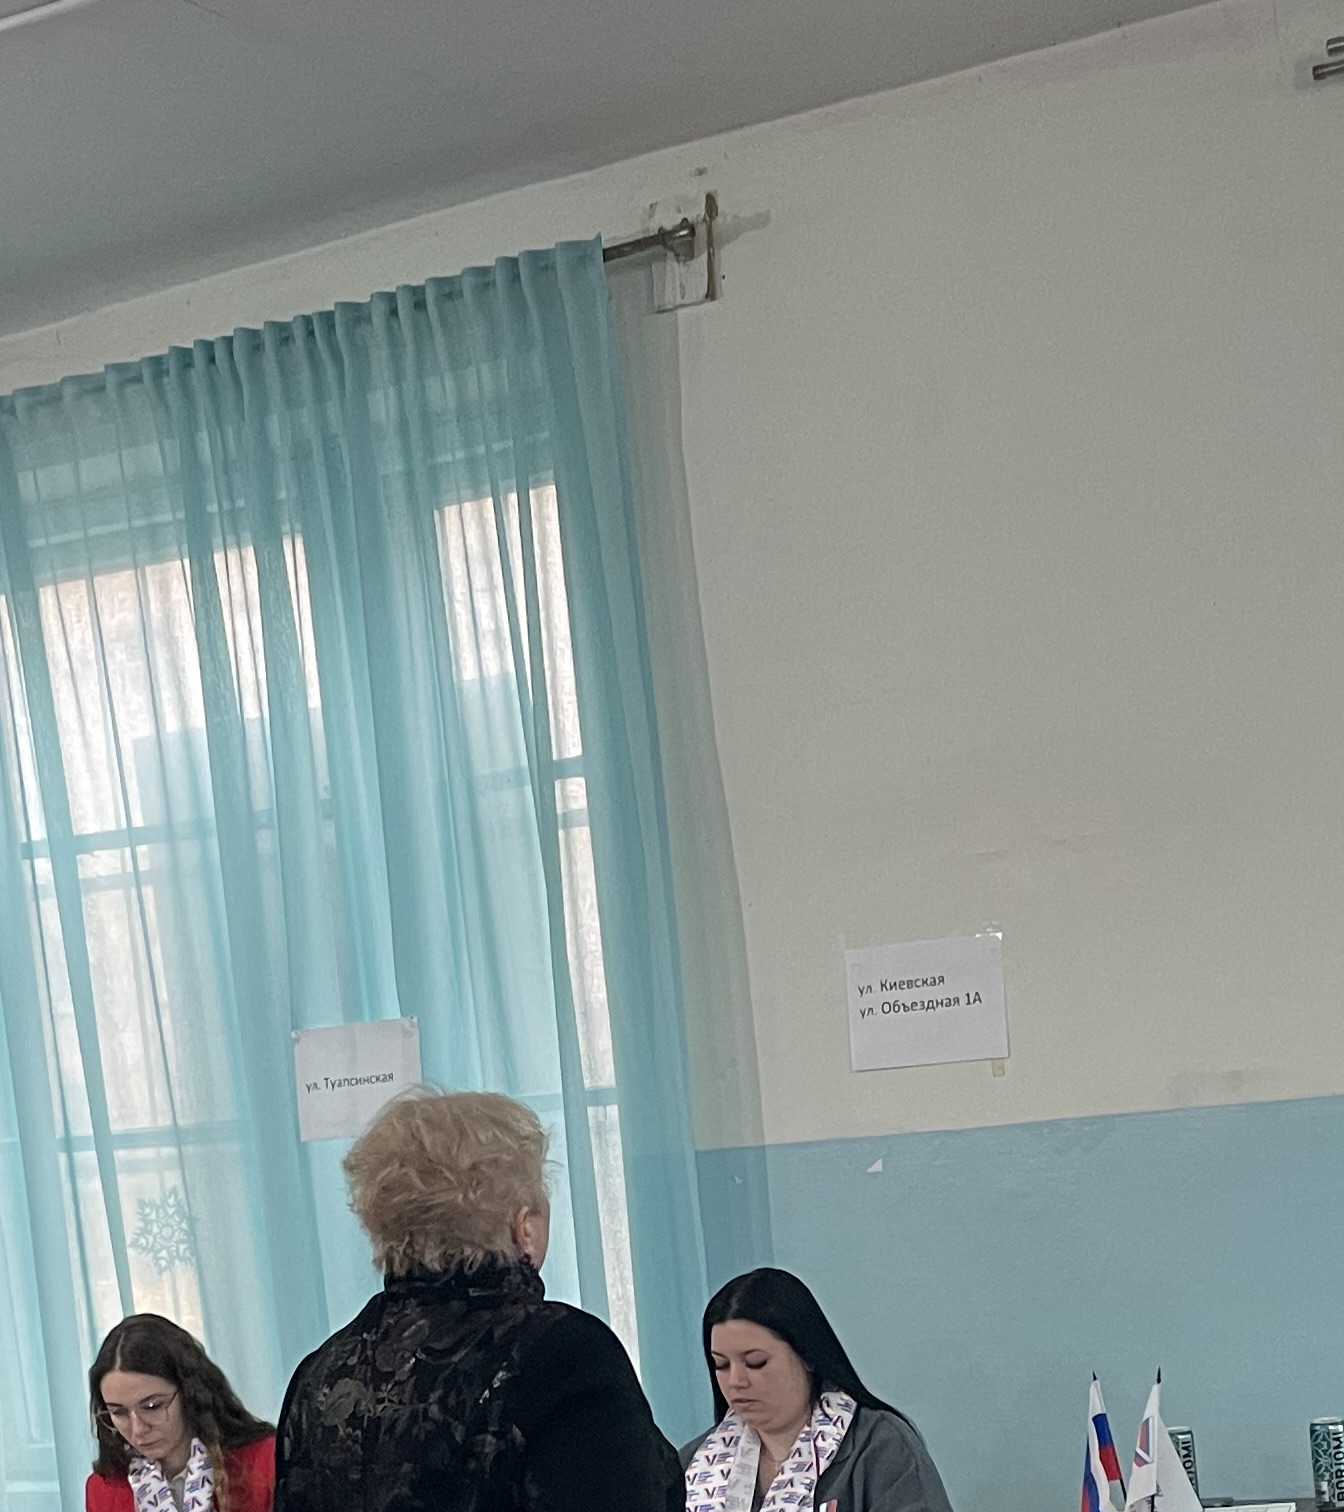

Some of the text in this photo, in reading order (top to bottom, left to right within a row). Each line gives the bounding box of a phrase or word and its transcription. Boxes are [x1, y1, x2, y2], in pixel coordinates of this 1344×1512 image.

[880, 975, 945, 993] Киевская
[859, 1007, 878, 1020] ул.
[881, 995, 960, 1015] Объездная
[305, 1072, 394, 1094] ул. Туапсинская
